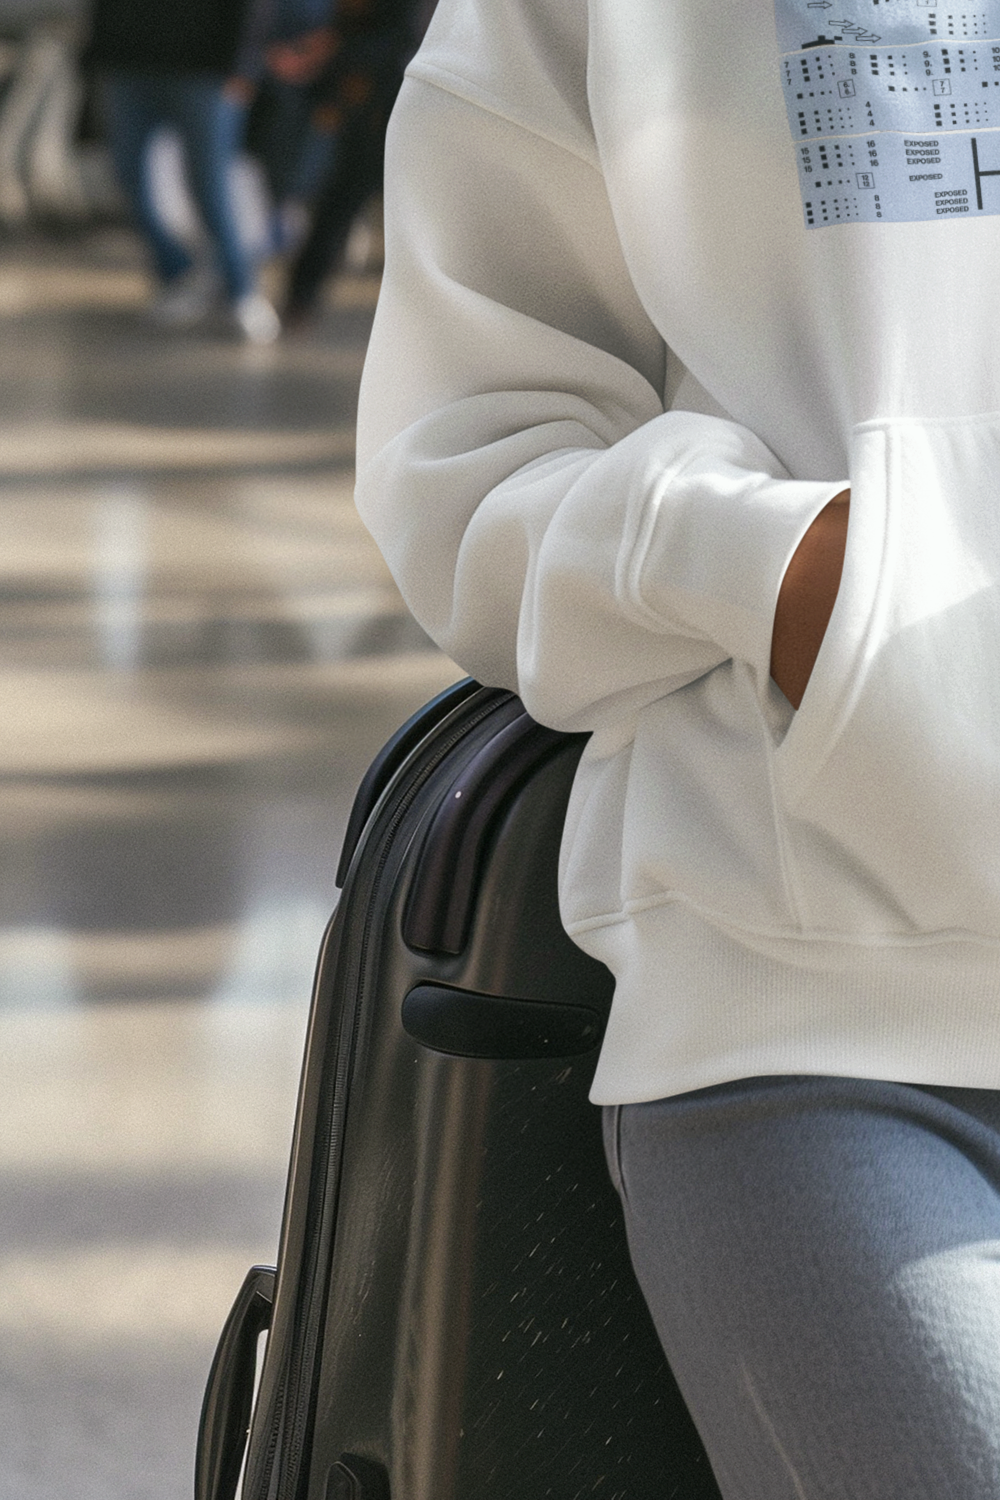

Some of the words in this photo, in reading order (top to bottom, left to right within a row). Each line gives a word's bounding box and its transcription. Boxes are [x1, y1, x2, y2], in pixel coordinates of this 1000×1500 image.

[934, 190, 968, 198] EXPOSED
[935, 198, 968, 206] EXPOSED
[936, 206, 969, 214] EXPOSED
